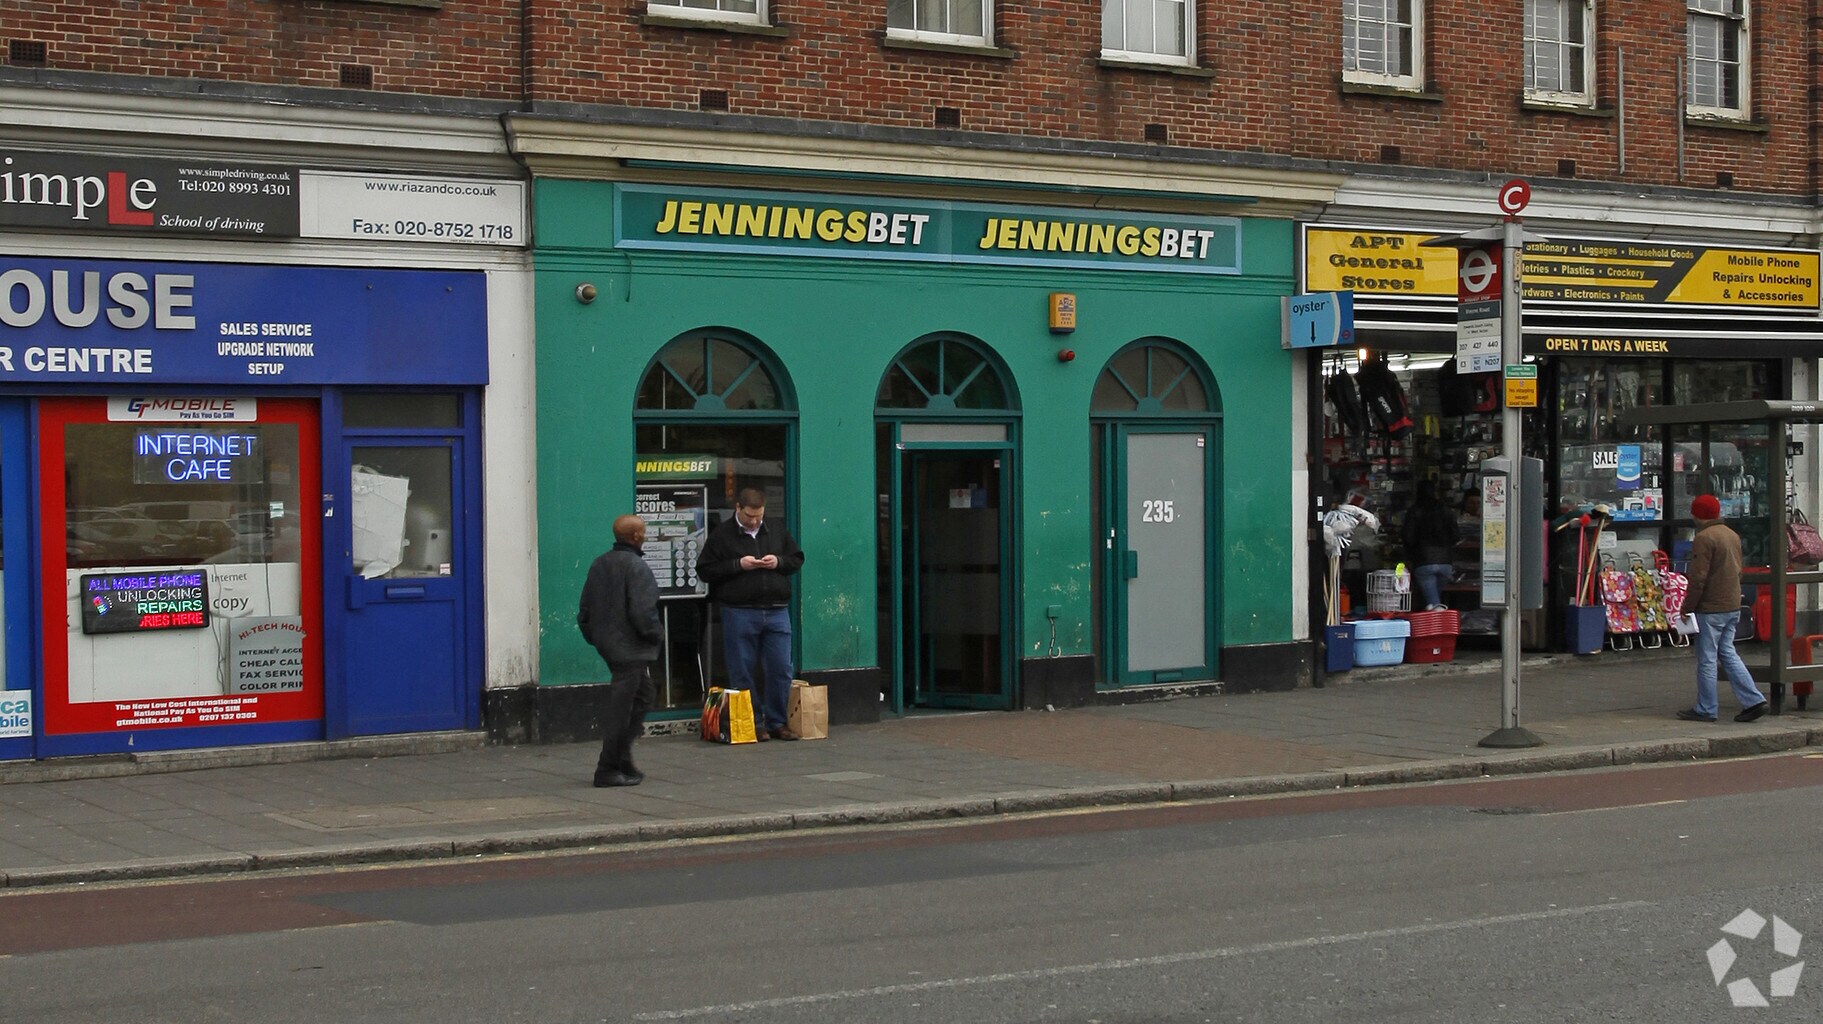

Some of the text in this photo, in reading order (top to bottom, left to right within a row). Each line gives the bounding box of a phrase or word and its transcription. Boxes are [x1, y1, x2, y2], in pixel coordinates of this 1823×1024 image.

[178, 167, 291, 182] www.simpledriving.co.uk
[178, 179, 291, 196] Tel:020 8993 4301
[365, 181, 497, 197] www.riazandco.co.uk
[1503, 186, 1523, 210] C
[160, 214, 265, 233] School of driving
[353, 219, 513, 240] Fax: 020-8752 1718
[656, 201, 930, 245] JENNINGSBET
[979, 218, 1215, 260] JENNINGSBET
[1350, 235, 1404, 250] APT
[1579, 245, 1618, 257] Luggages
[1628, 247, 1668, 258] Household
[1670, 249, 1694, 260] Goods
[1329, 253, 1424, 270] General
[1727, 255, 1800, 268] Mobile Phone
[1561, 264, 1595, 276] Plastics
[1607, 267, 1645, 280] Crockery
[1712, 271, 1812, 288] Repairs Unlocking
[1341, 275, 1415, 290] Stores
[0, 269, 196, 330] OUSE
[1564, 288, 1611, 300] Electronics
[1620, 291, 1645, 302] Paints
[1722, 289, 1804, 302] & Accessories
[1292, 300, 1325, 316] oyster
[220, 322, 312, 336] SALES SERVICE
[217, 342, 314, 357] UPGRADE NETWORK
[1487, 340, 1499, 348] 440
[1545, 338, 1669, 353] OPEN 7 DAYS A WEEK
[24, 347, 153, 373] CENTRE
[1485, 358, 1500, 366] N207
[248, 363, 284, 375] SETUP
[180, 412, 191, 420] Pay
[138, 433, 257, 456] INTERNET
[1594, 451, 1617, 466] SALE
[167, 458, 232, 481] CAFE
[636, 501, 676, 513] scores
[1143, 500, 1174, 523] 235
[88, 579, 111, 591] ALL
[112, 576, 157, 590] MOBILE
[158, 574, 202, 588] PHONE
[211, 573, 248, 583] Internet
[117, 587, 202, 603] UNLOCKING
[137, 599, 203, 615] REPAIRS
[213, 597, 249, 611] copy
[172, 612, 204, 626] HERE
[239, 622, 278, 641] HI-TECH
[239, 647, 280, 656] INTERNET
[239, 659, 276, 668] CHEAP
[240, 671, 261, 679] FAX
[240, 681, 277, 691] COLOR
[188, 698, 241, 707] International
[134, 709, 168, 717] National
[170, 708, 184, 716] Pay
